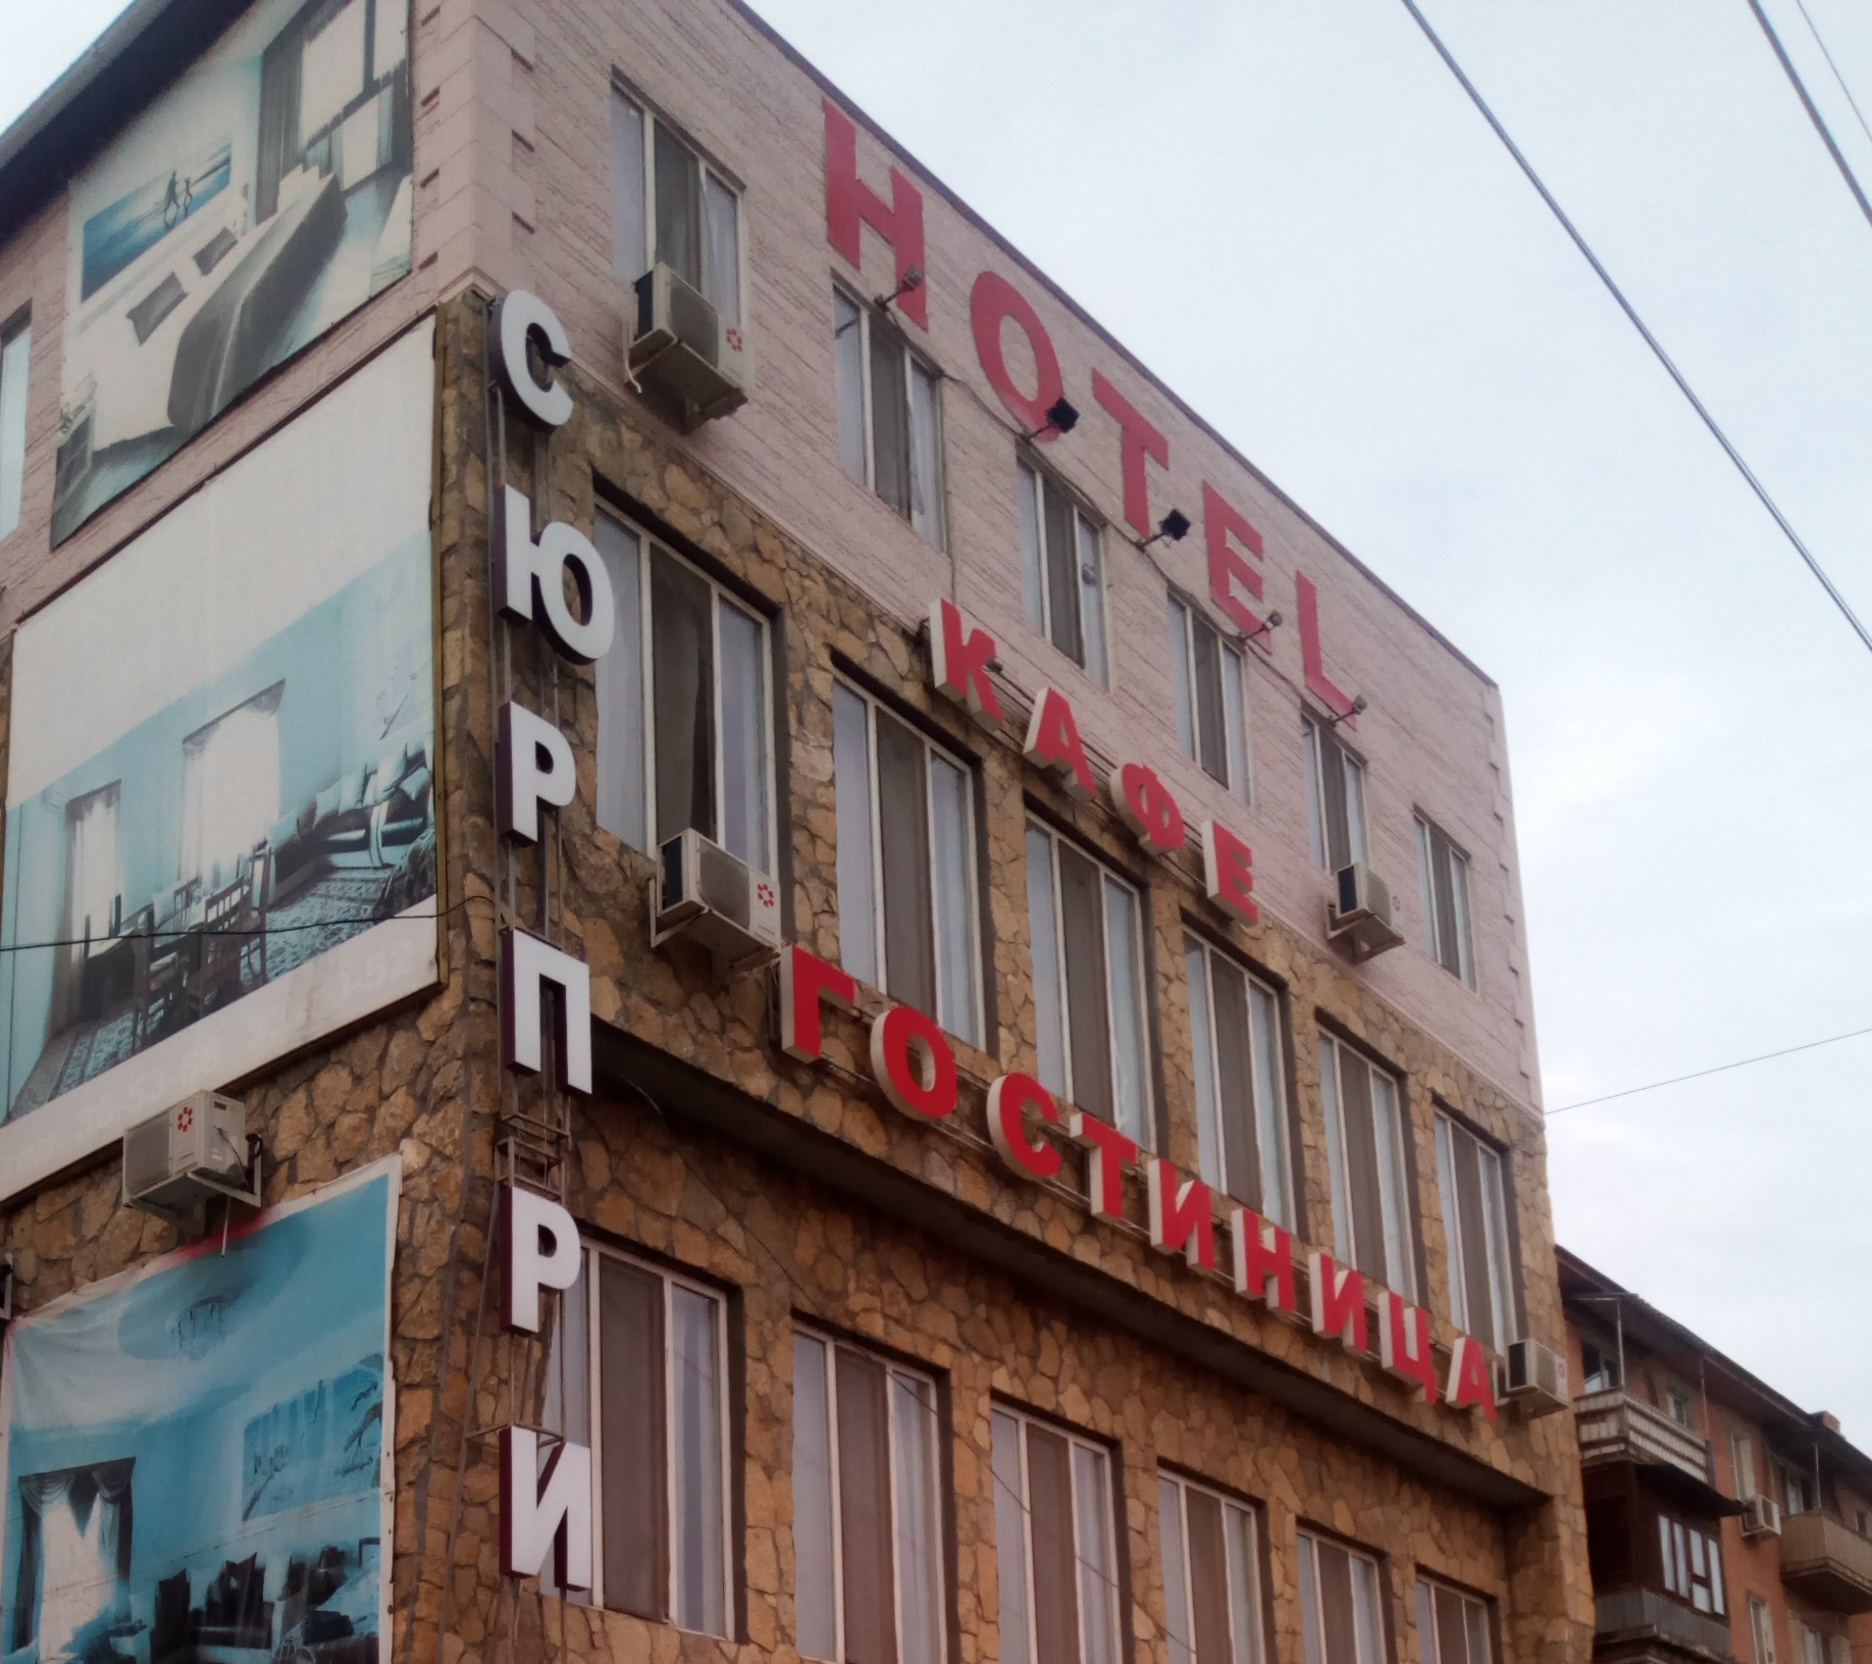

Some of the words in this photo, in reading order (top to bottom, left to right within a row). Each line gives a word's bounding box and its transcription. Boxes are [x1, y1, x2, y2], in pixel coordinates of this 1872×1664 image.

[821, 94, 1357, 730] HOTEL
[929, 598, 1259, 927] КАФЕ
[781, 944, 1496, 1421] ГОСТИНИЦА
